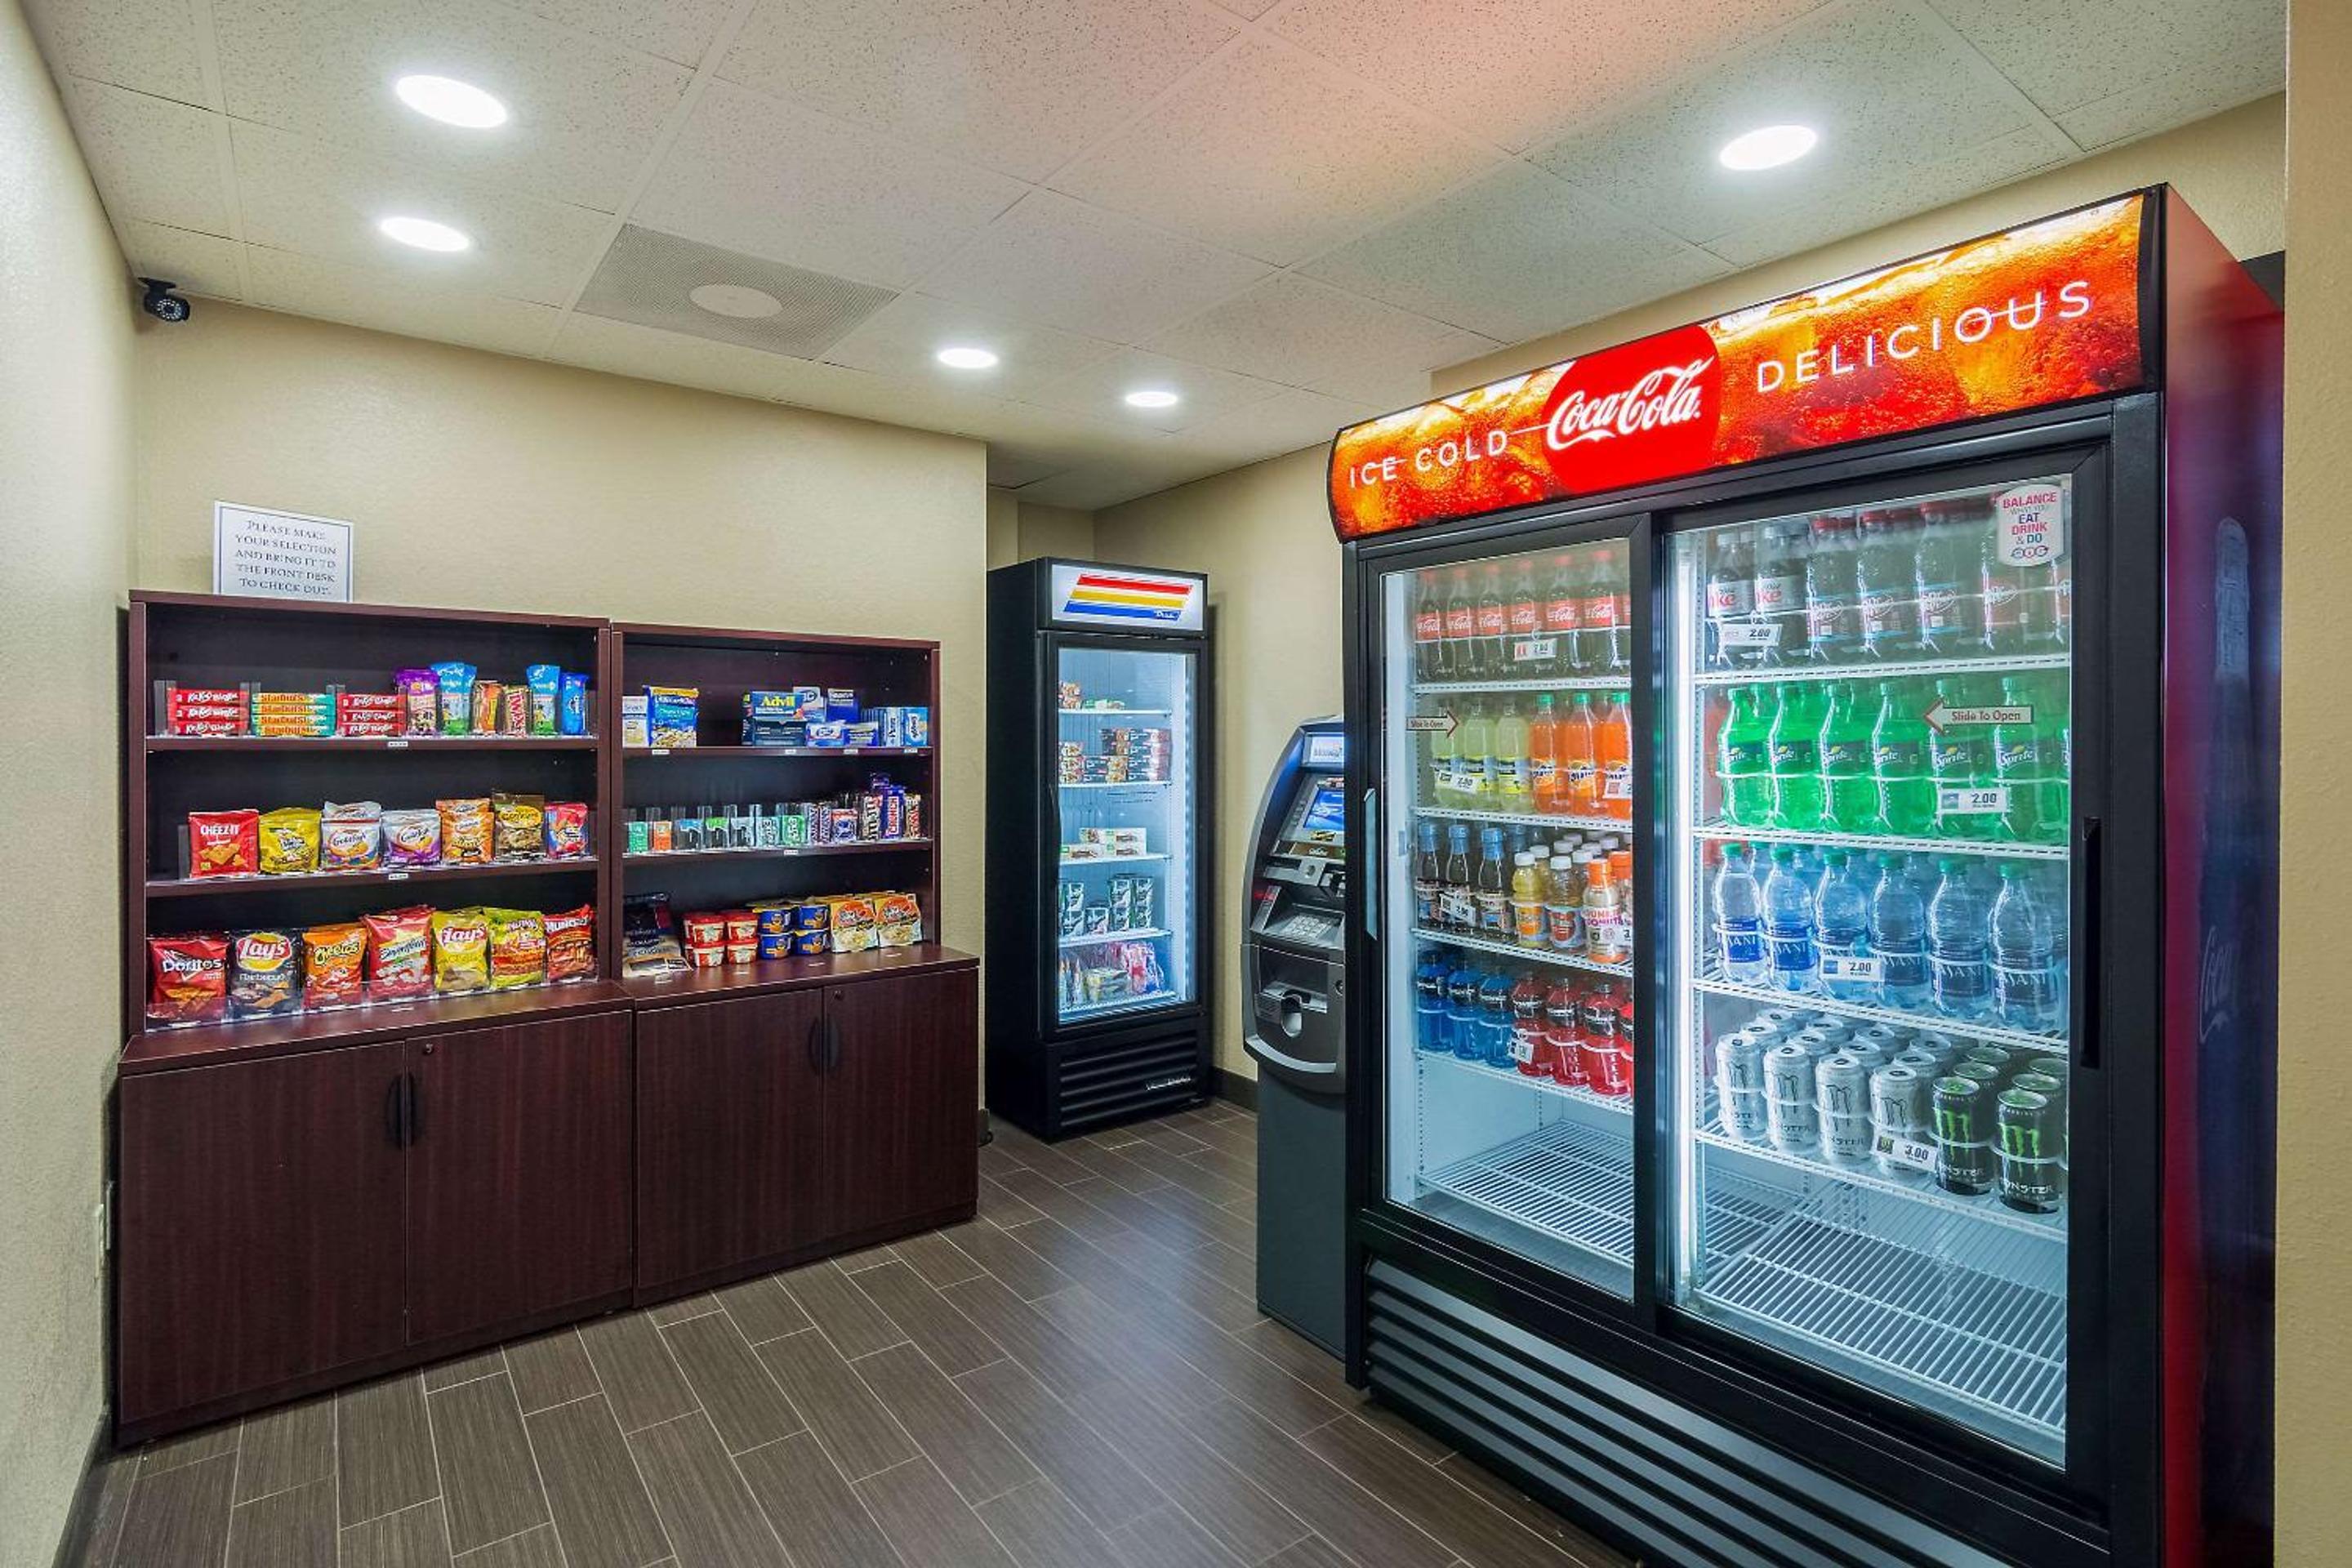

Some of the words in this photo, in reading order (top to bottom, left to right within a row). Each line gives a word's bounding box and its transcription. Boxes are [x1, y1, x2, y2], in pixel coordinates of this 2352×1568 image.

[1349, 457, 1398, 488] ICE
[1414, 430, 1508, 472] COLD
[1547, 355, 1714, 451] Coca-Cola
[1757, 280, 2091, 393] DELICIOUS
[2002, 492, 2057, 509] BALANCE
[2019, 512, 2040, 524] EAT
[247, 519, 290, 536] PLEASE
[294, 528, 327, 540] MAKE
[2011, 522, 2047, 536] DRINK
[235, 534, 271, 546] YOUR
[272, 539, 336, 555] SELECTION
[2027, 533, 2042, 544] DO
[235, 549, 263, 559] AND
[265, 551, 302, 566] BRING
[305, 558, 318, 568] IT
[319, 559, 336, 569] TO
[237, 564, 261, 575] THE
[264, 565, 303, 580] FRONT
[306, 572, 336, 583] DESK
[239, 577, 258, 588] TO
[260, 581, 301, 593] CHECK
[1749, 628, 1771, 638] 2.00
[760, 695, 795, 706] Advil
[1951, 710, 1976, 721] Slide
[1979, 710, 1990, 720] To
[1992, 710, 2021, 722] Open
[2001, 750, 2035, 770] Sprite
[1971, 792, 1998, 804] 2.00
[162, 957, 223, 973] Doritos
[1848, 961, 1872, 973] 2.00
[1904, 1144, 1931, 1161] 3.00
